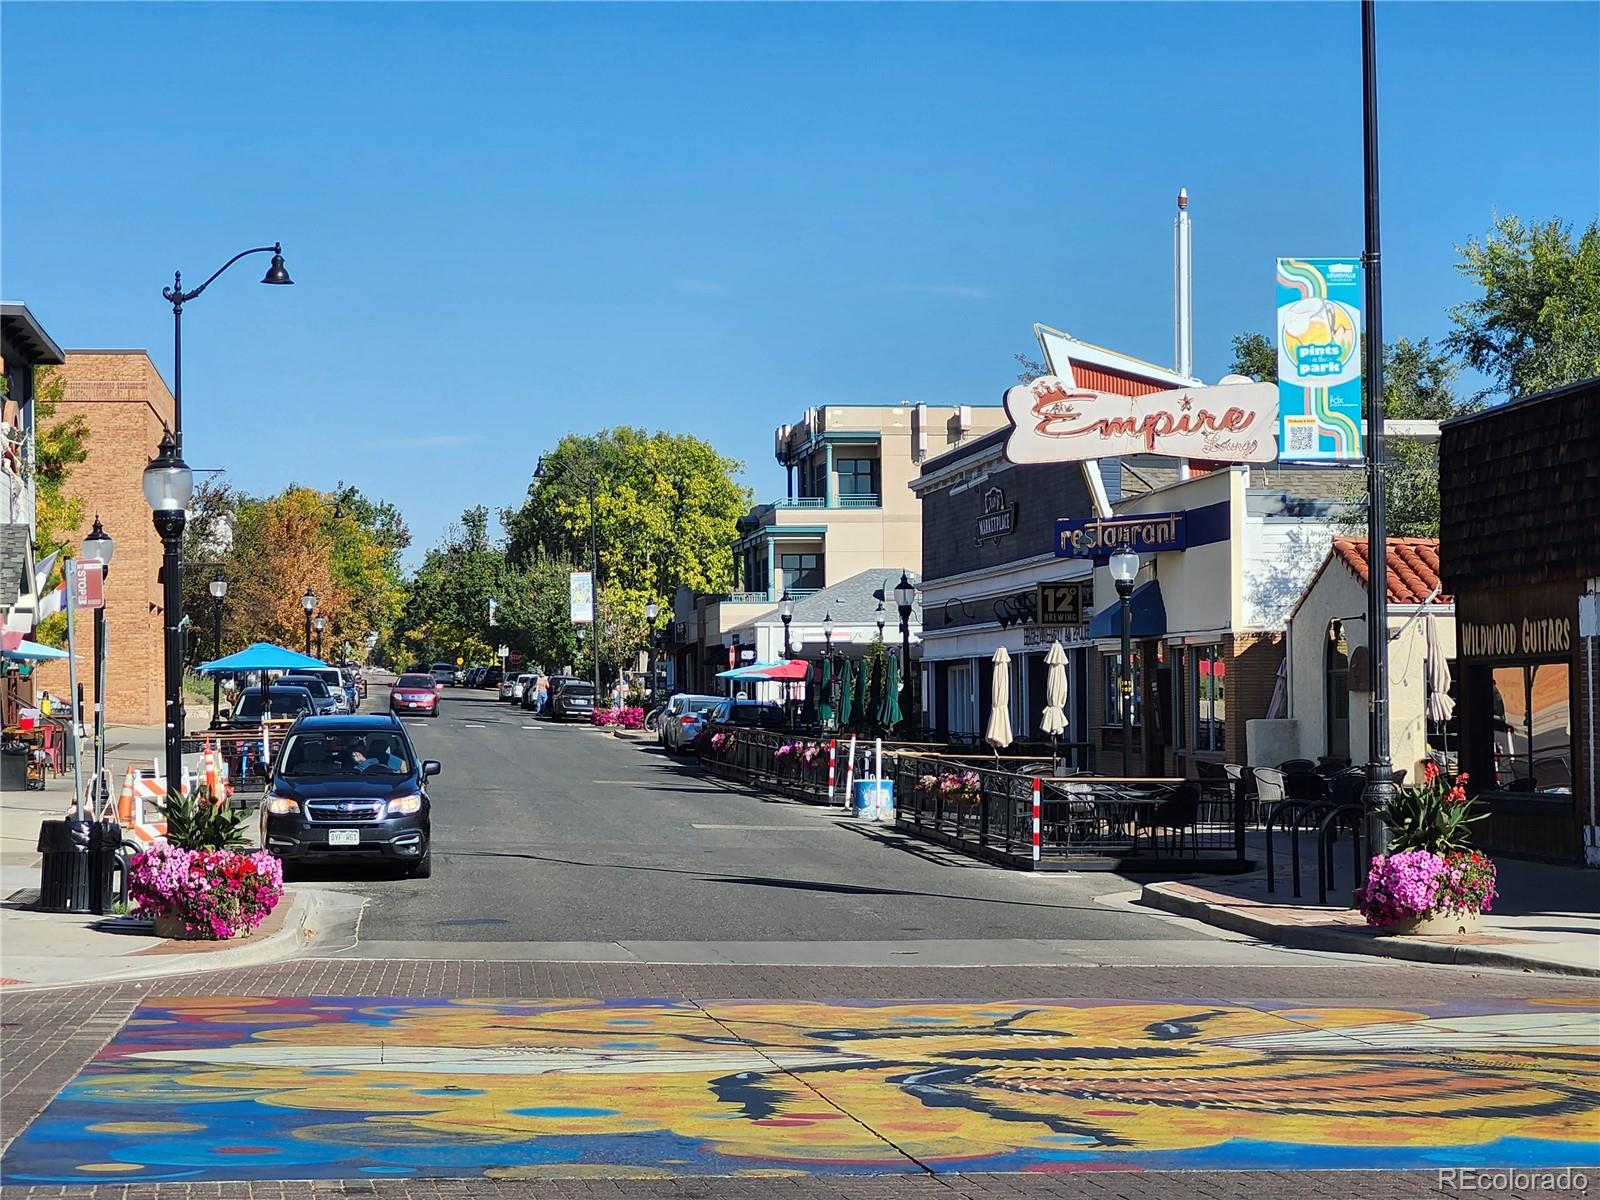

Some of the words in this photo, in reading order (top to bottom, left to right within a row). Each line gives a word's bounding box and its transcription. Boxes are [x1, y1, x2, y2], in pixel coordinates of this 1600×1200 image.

[1299, 346, 1340, 358] pints
[1299, 362, 1341, 375] park
[1032, 390, 1257, 452] Empire
[978, 512, 1010, 537] MARKETPLACE
[1060, 513, 1183, 551] restaurant
[77, 569, 88, 596] STOP
[1043, 612, 1077, 622] BREWING
[1461, 621, 1518, 656] WILDWOOD
[1521, 616, 1571, 654] GUITARS
